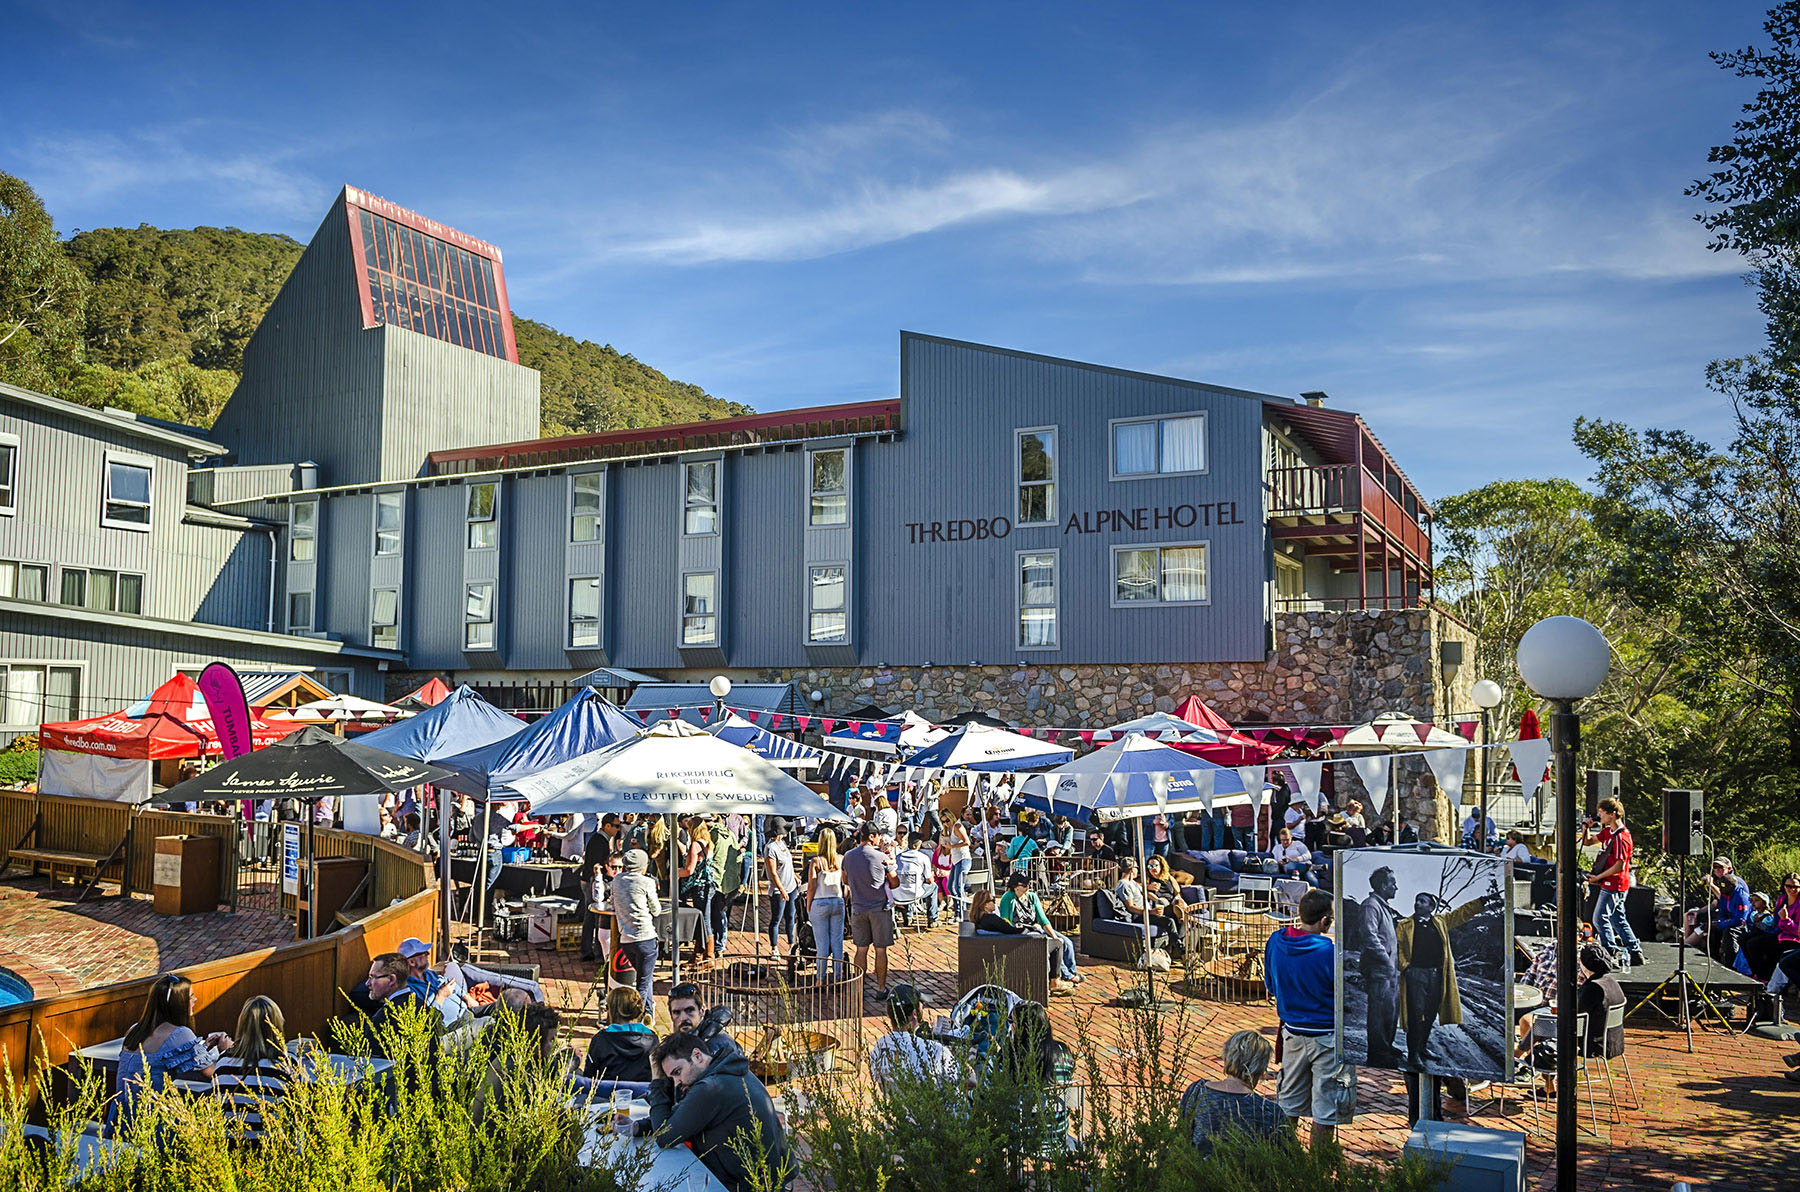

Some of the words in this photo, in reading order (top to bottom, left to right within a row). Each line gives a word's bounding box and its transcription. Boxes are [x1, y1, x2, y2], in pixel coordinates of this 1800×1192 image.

[1064, 507, 1149, 535] ALPINE
[1154, 502, 1244, 530] HOTEL
[906, 517, 1011, 544] THREDBO
[222, 771, 275, 787] James
[623, 792, 711, 801] BEAUTIFULLY
[715, 793, 775, 803] SWEDISH
